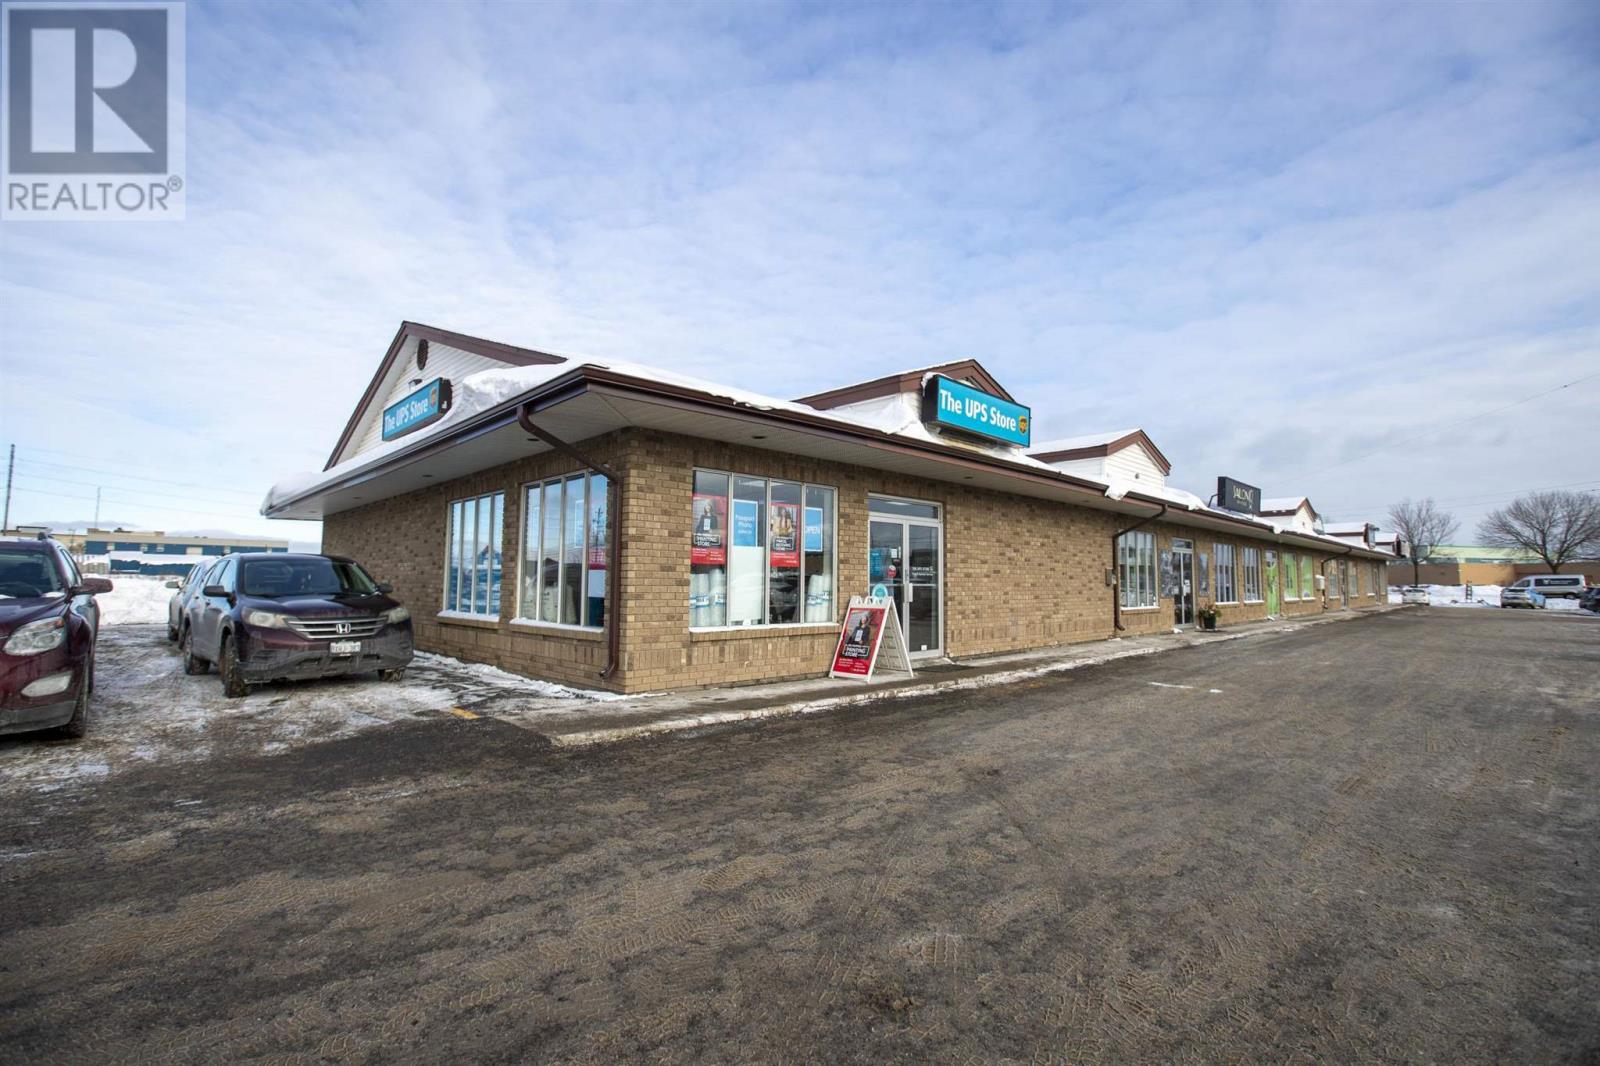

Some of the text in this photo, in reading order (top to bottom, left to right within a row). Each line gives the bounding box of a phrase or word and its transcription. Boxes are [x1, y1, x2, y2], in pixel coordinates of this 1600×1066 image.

[385, 398, 429, 432] The UPS Store
[939, 389, 962, 414] The
[965, 398, 987, 422] UPS
[990, 407, 1016, 431] Store
